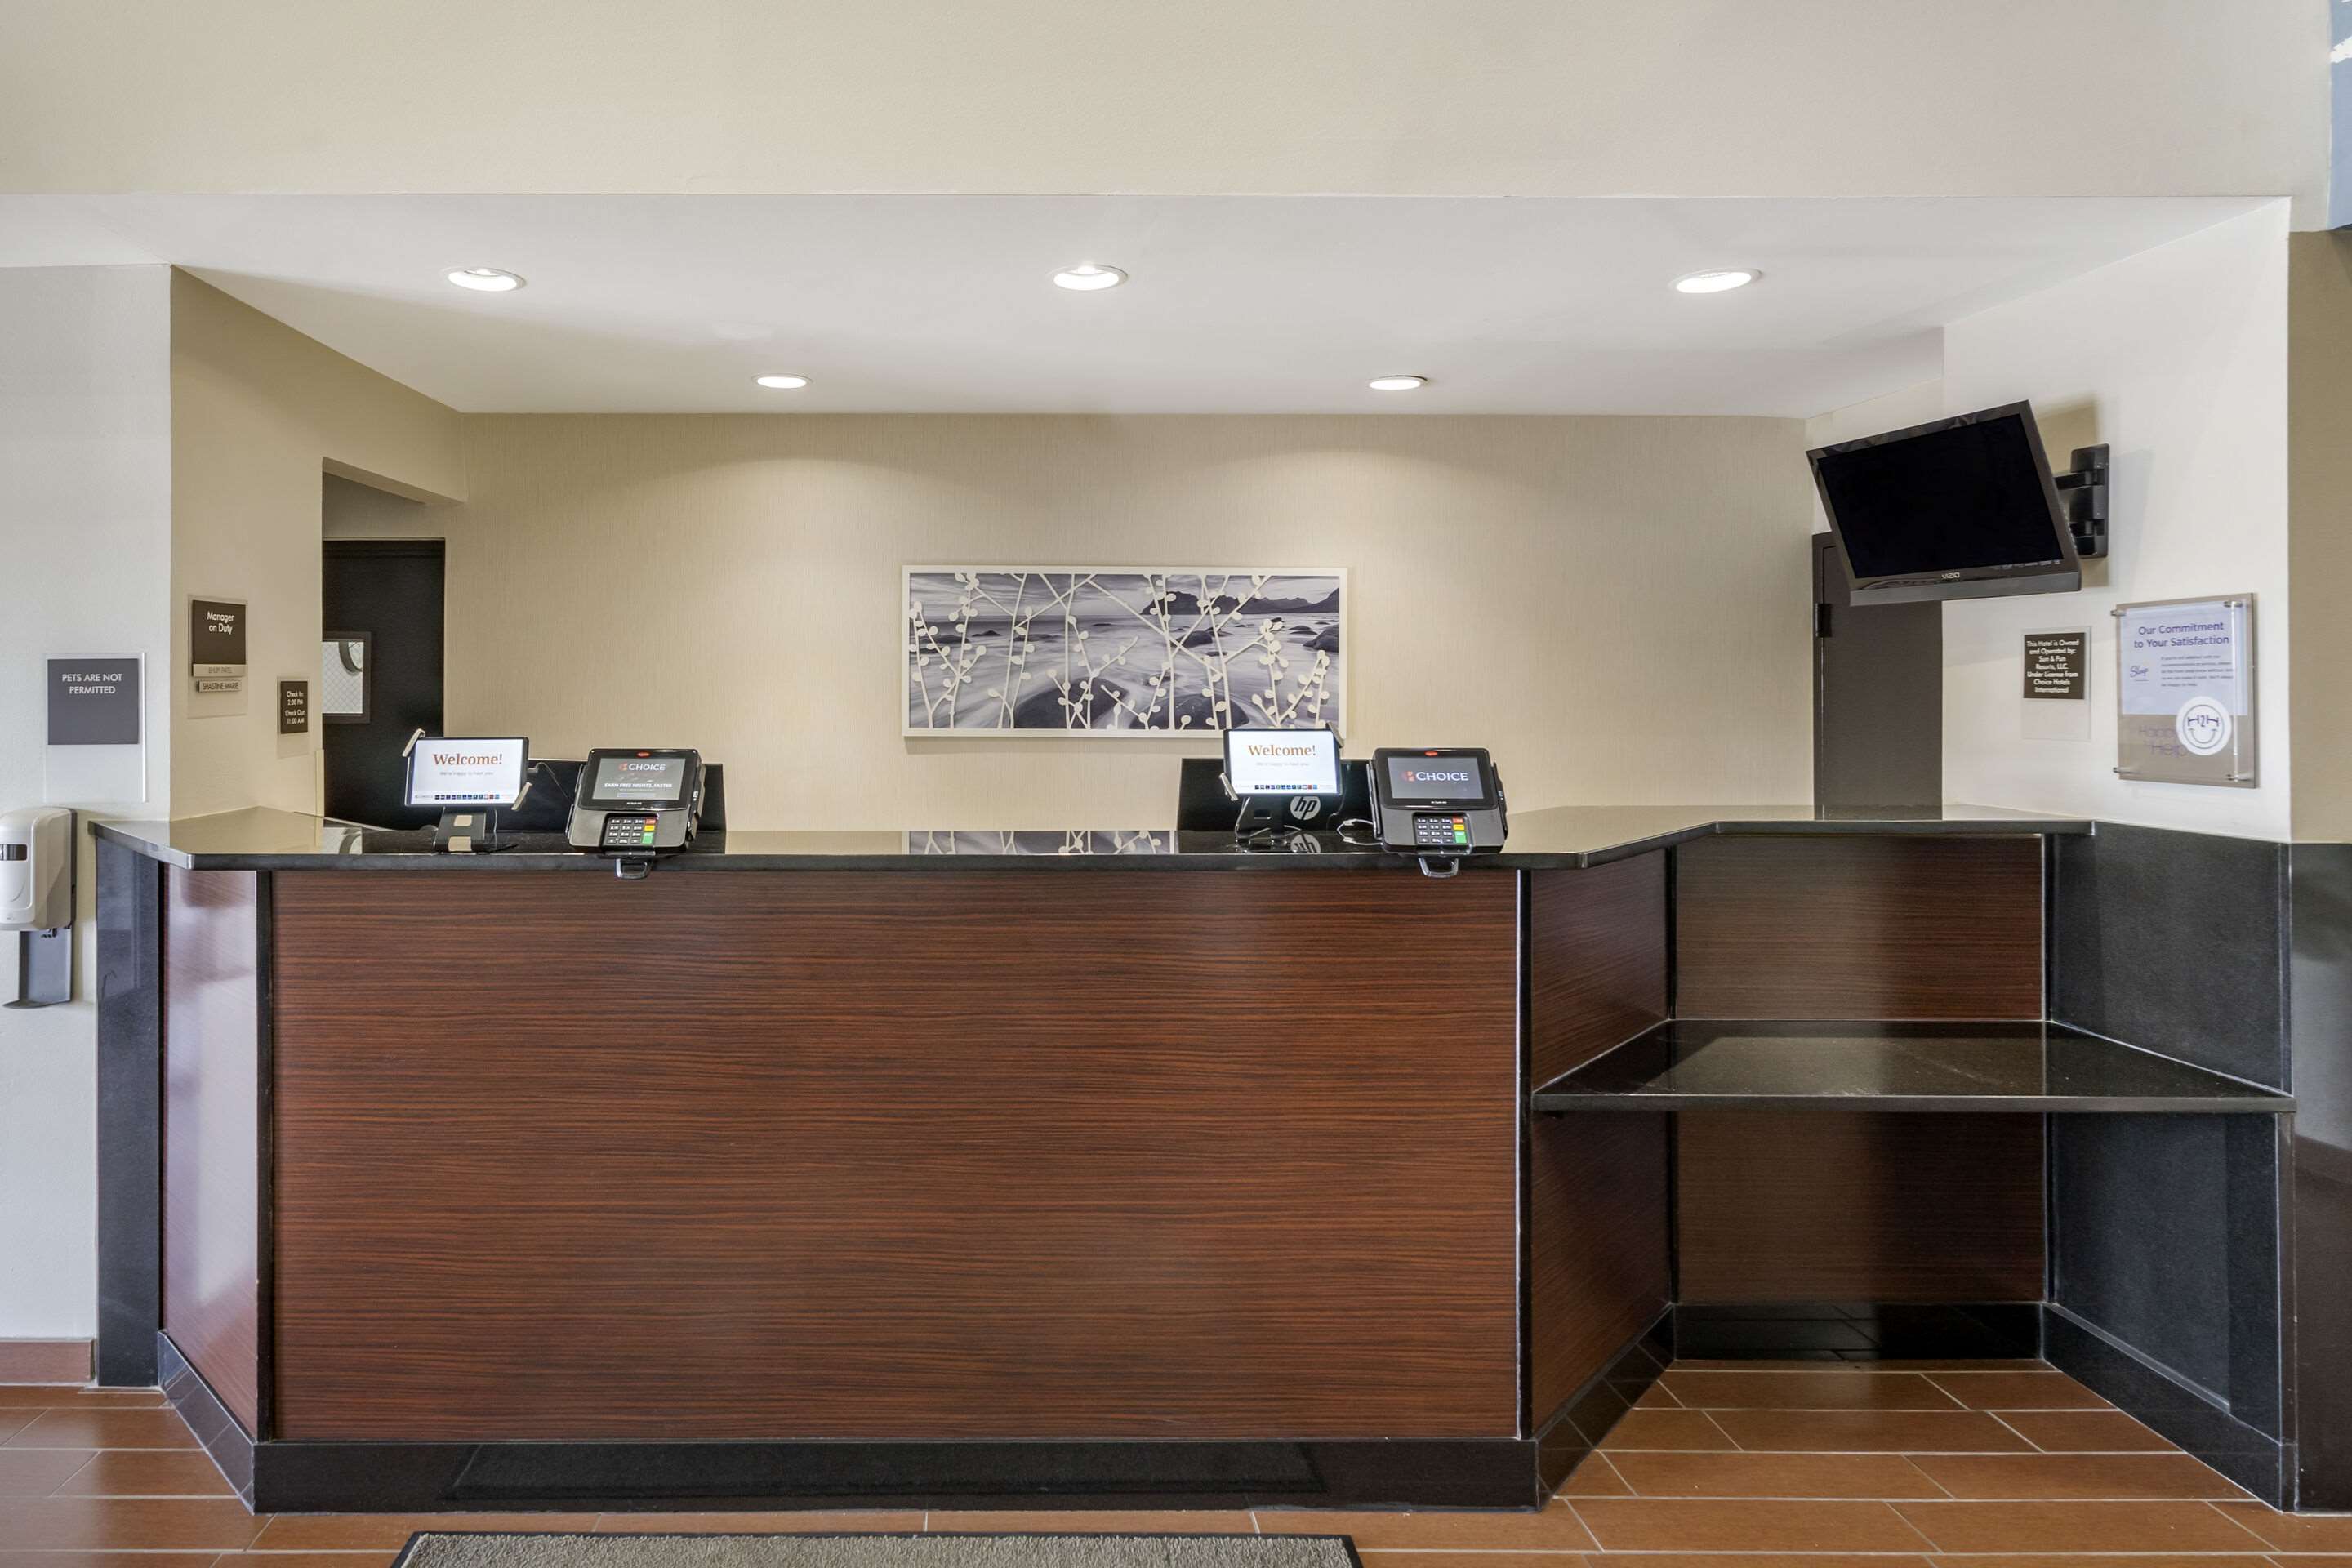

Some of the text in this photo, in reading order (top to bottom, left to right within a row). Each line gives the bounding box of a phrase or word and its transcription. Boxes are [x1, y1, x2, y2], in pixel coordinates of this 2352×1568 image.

[207, 611, 234, 623] Manager
[219, 623, 233, 635] Duty
[2138, 622, 2225, 635] Our Commitment
[2134, 635, 2230, 648] to Your Satisfaction
[62, 673, 123, 682] PETS ARE NOT
[69, 686, 116, 694] PERMITTED
[1248, 745, 1316, 756] Welcome!
[434, 753, 503, 765] Welcome!
[628, 763, 666, 771] CHOICE
[1416, 772, 1468, 781] CHOICE
[1294, 796, 1317, 820] hp
